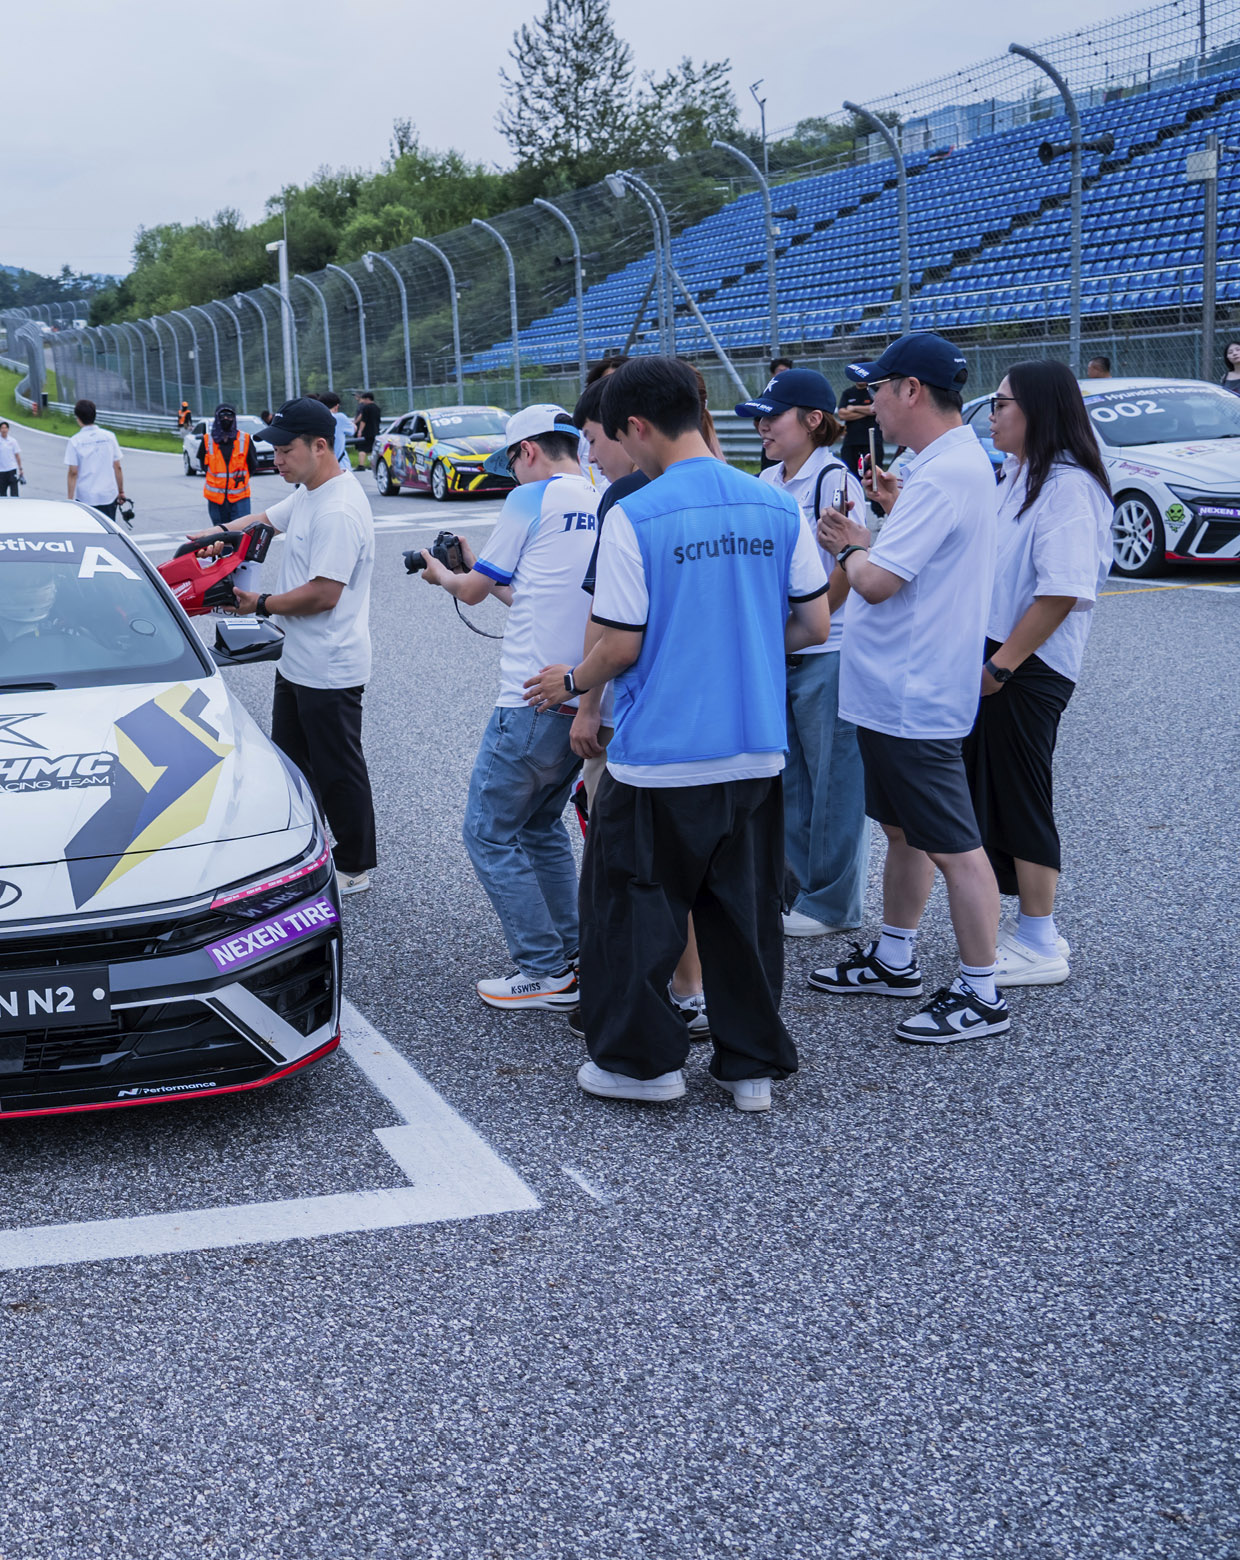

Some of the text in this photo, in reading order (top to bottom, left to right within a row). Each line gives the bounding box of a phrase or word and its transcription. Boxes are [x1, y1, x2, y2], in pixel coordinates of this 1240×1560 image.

[1090, 400, 1166, 423] 002
[431, 416, 463, 428] 199
[1199, 506, 1233, 517] NEXEN
[673, 532, 775, 565] scrutinee
[77, 546, 143, 581] A
[58, 775, 110, 788] TEAM
[211, 901, 336, 966] NEXEN TIRE
[511, 982, 541, 995] K-SWISS
[27, 985, 76, 1016] N2
[143, 1081, 217, 1095] Performance
